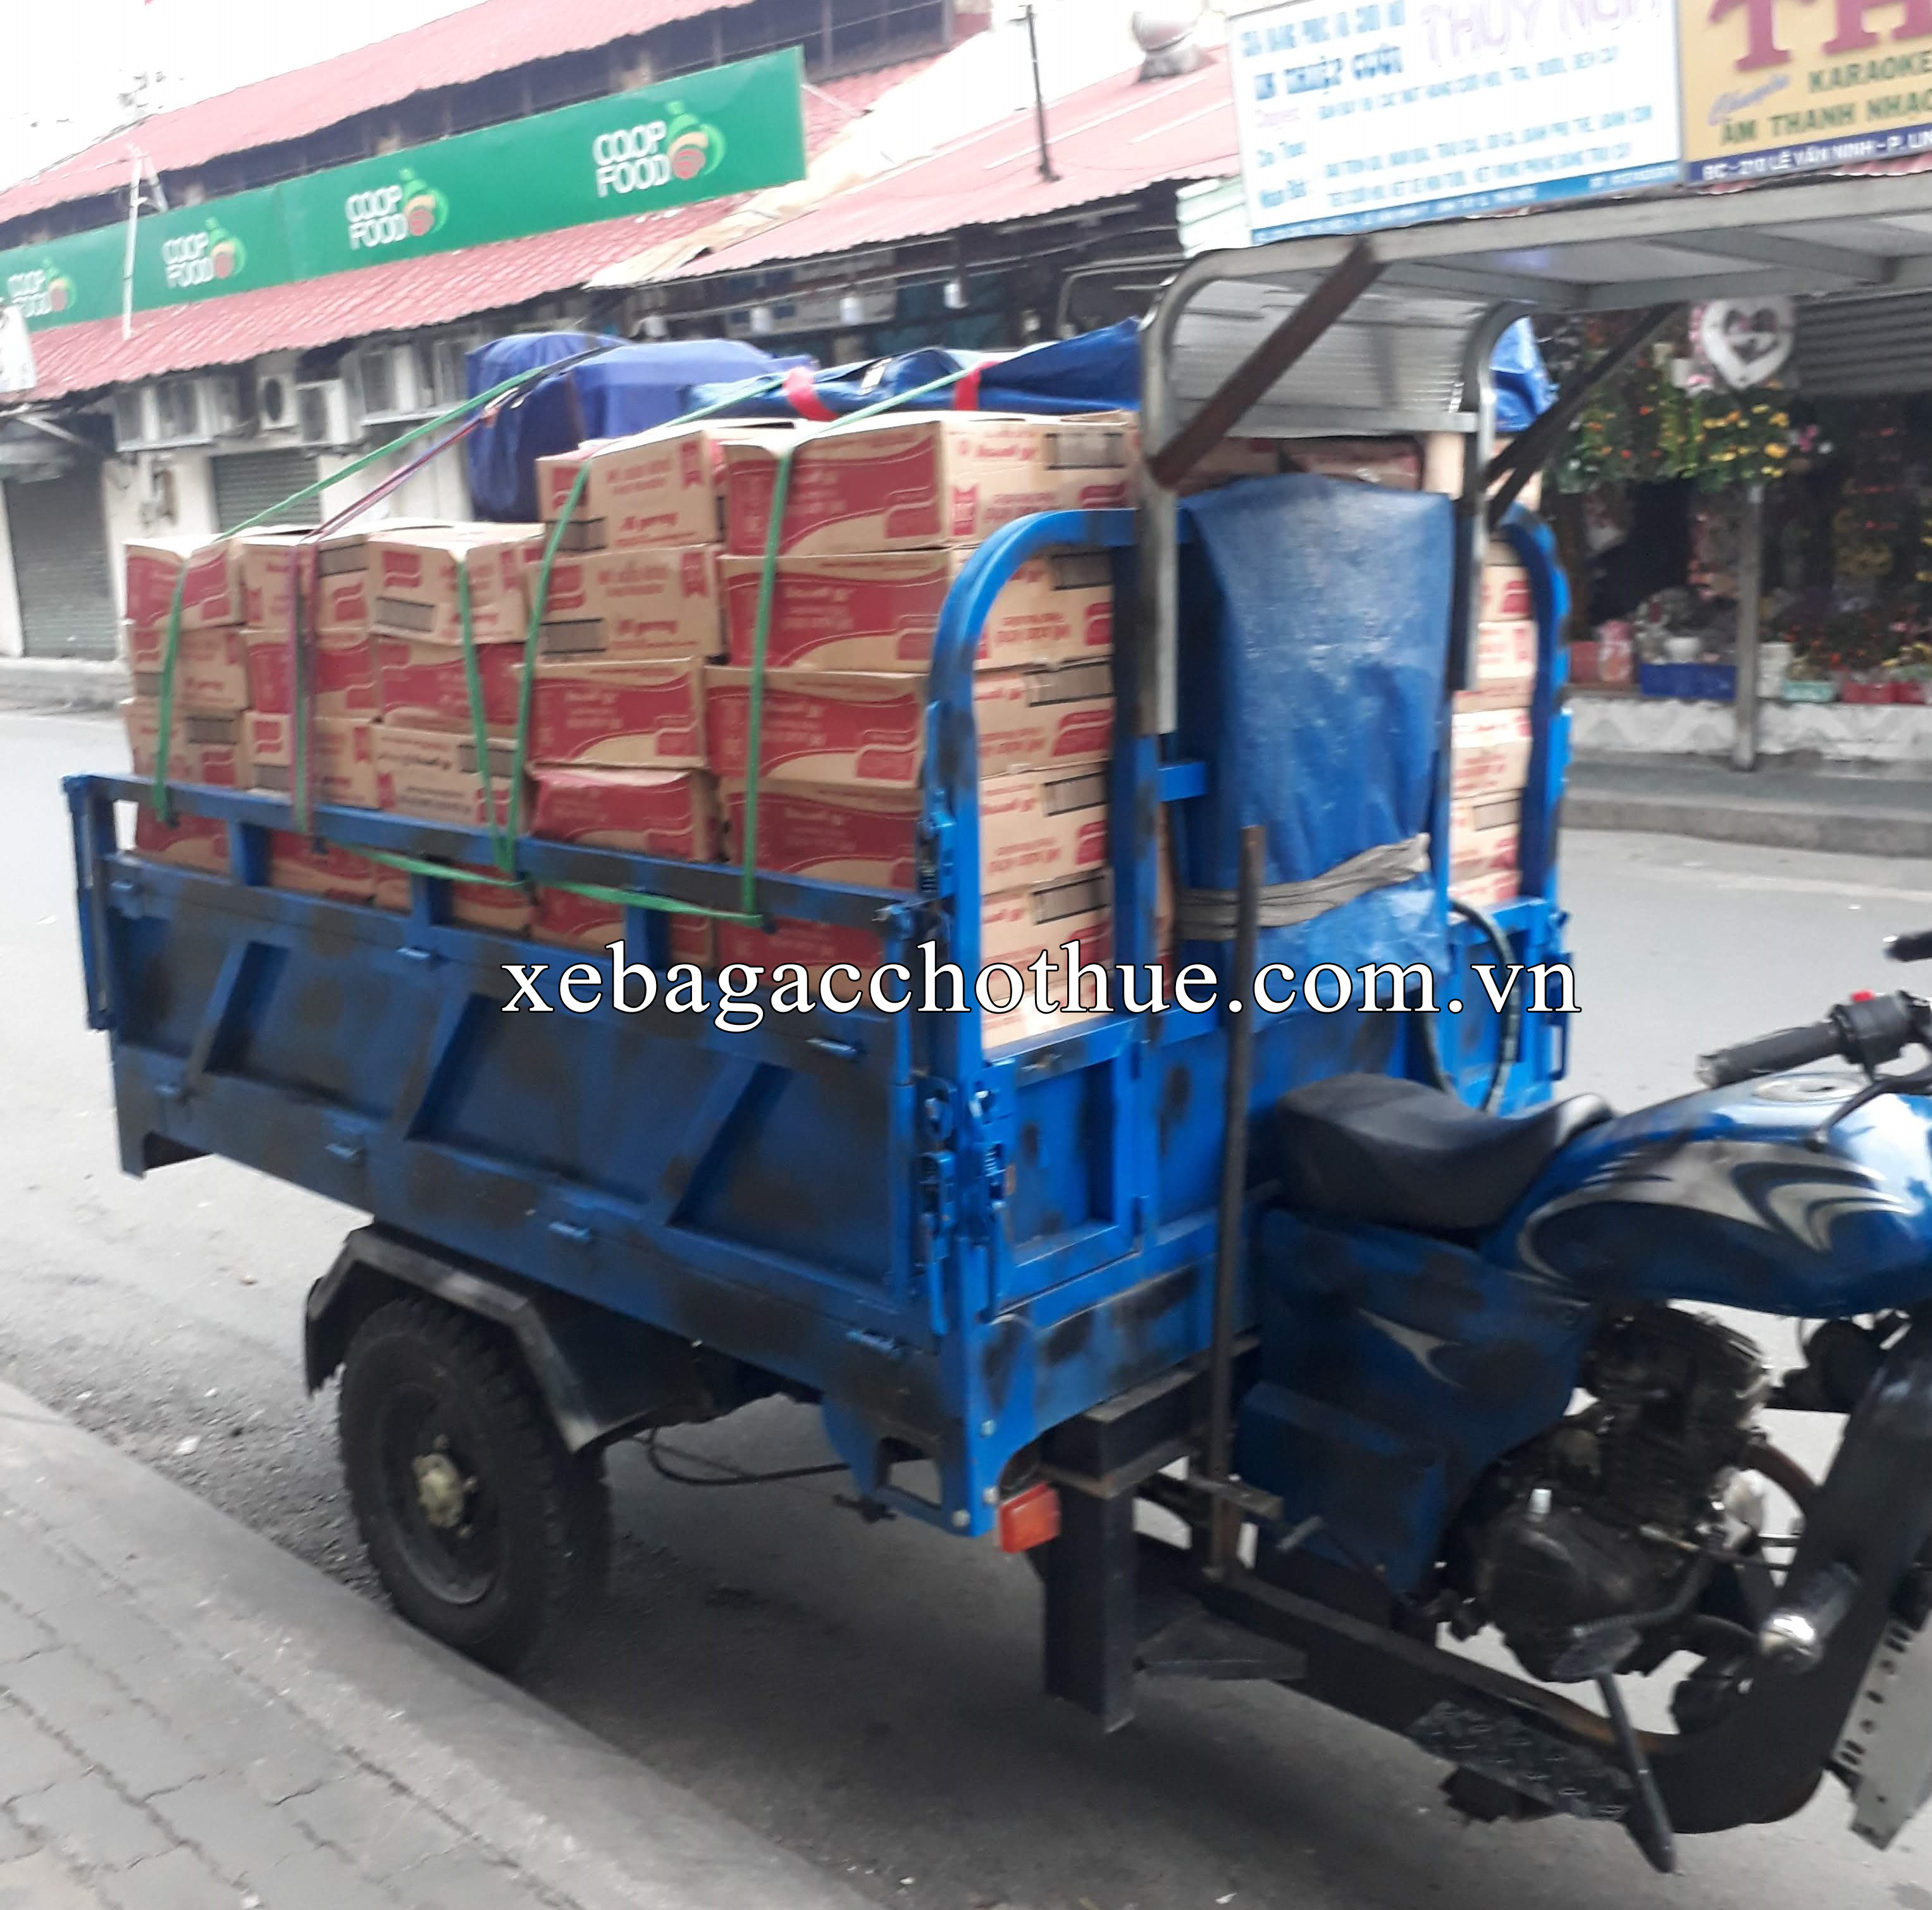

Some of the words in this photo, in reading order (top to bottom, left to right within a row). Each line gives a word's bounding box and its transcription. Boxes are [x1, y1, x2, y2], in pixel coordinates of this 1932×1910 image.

[1807, 51, 1932, 94] KARAOKE
[1768, 103, 1857, 137] THANH
[597, 154, 671, 198] FOOD
[349, 213, 407, 250] FOOD
[166, 256, 216, 289] FOOD
